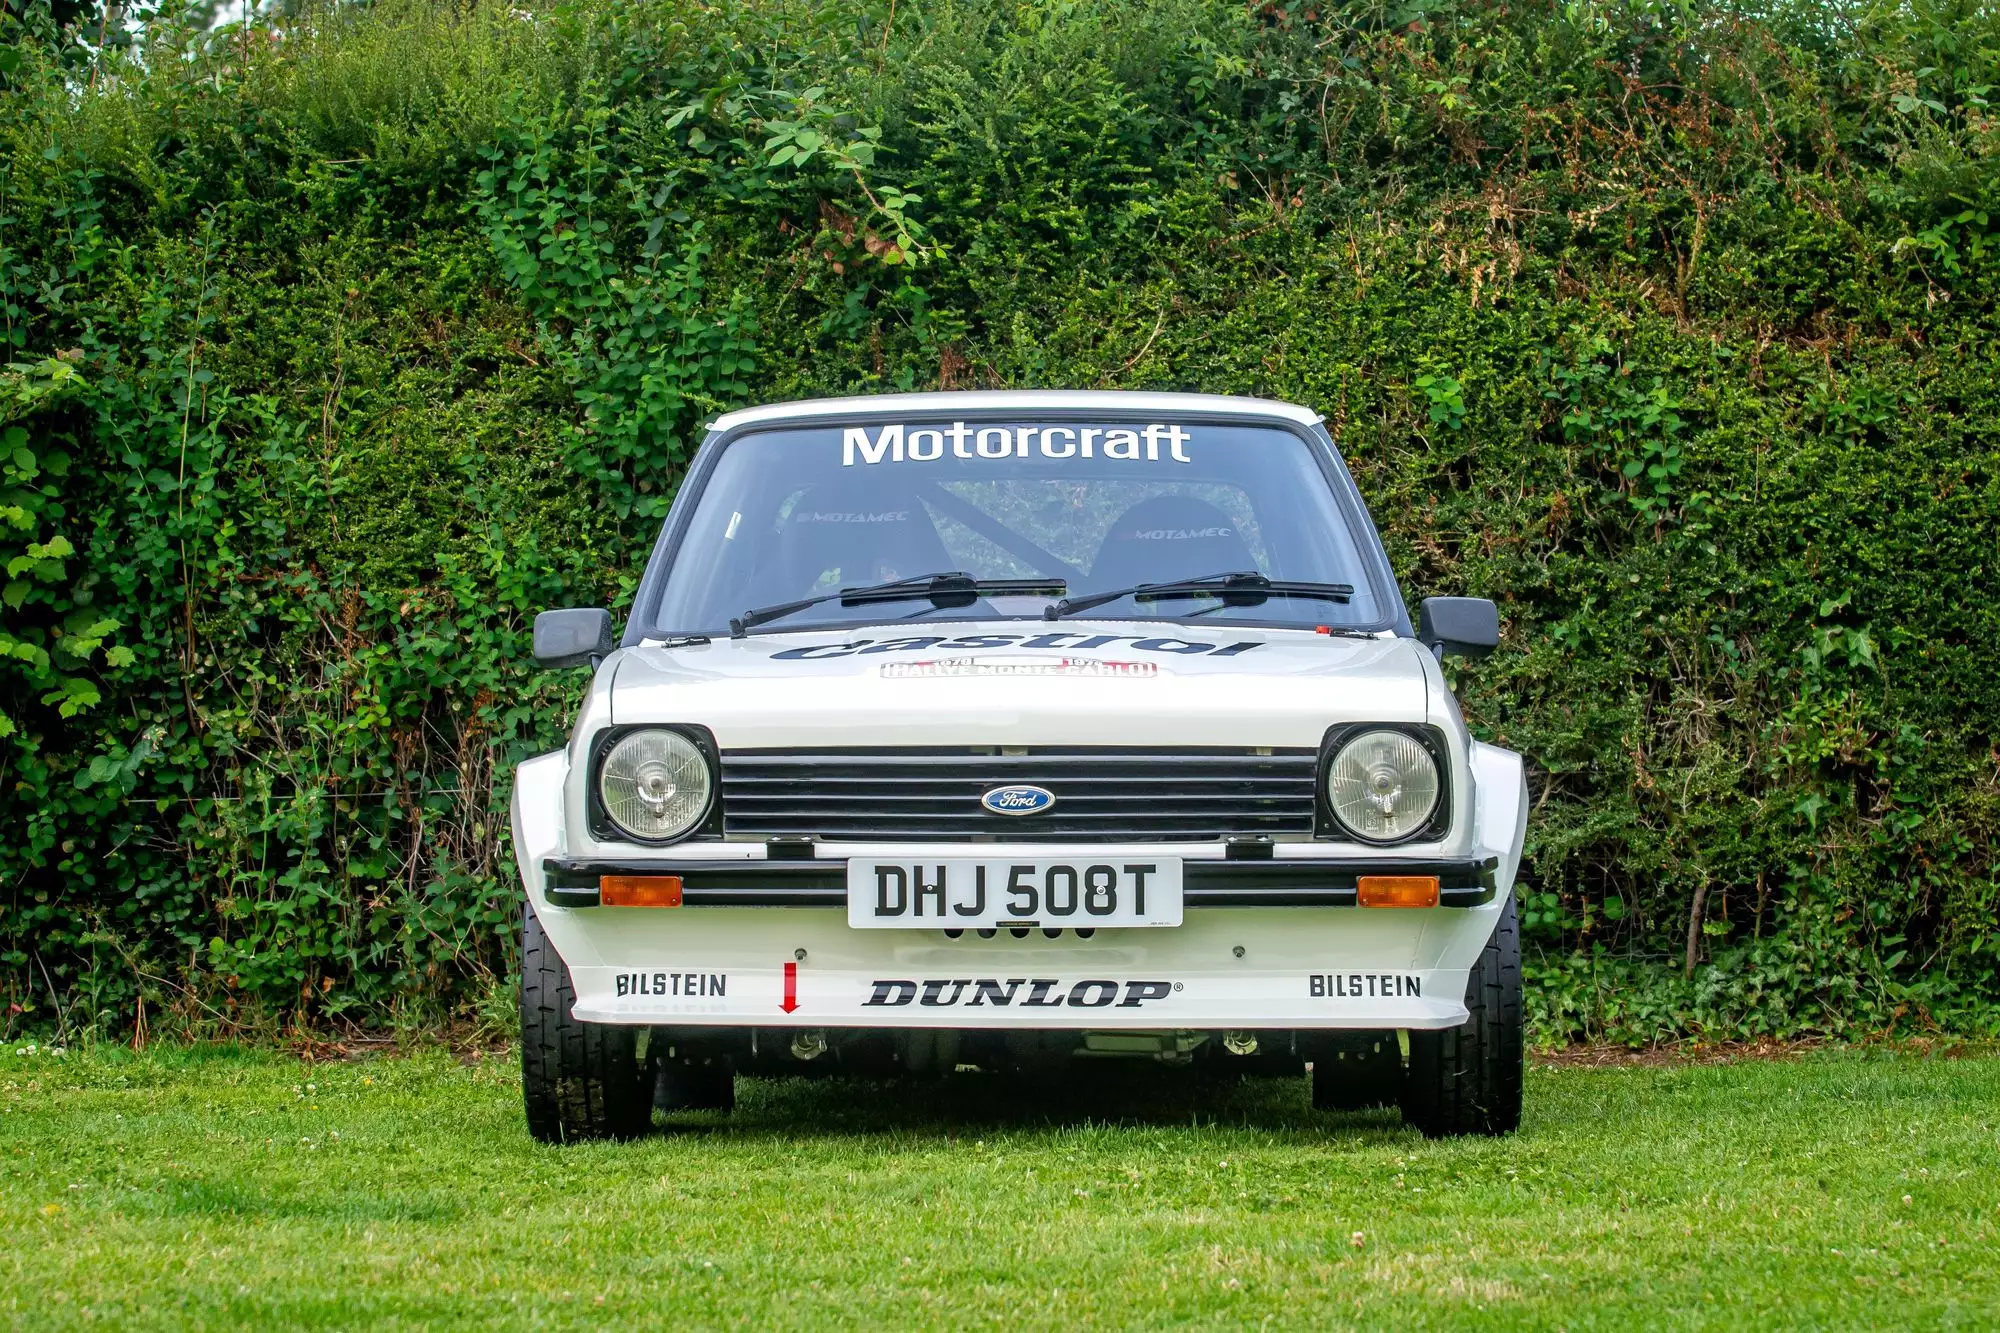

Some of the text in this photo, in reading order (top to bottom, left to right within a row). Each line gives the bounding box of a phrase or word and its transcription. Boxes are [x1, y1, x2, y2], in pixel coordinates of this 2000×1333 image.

[842, 421, 1191, 467] Motorcraft
[812, 511, 909, 522] MOTAMEC
[1136, 527, 1231, 540] MOTAMEC
[1000, 790, 1037, 807] Ford
[874, 864, 1156, 917] DHJ 508T
[616, 973, 727, 997] BILSTEIN
[1309, 974, 1421, 998] BILSTEIN
